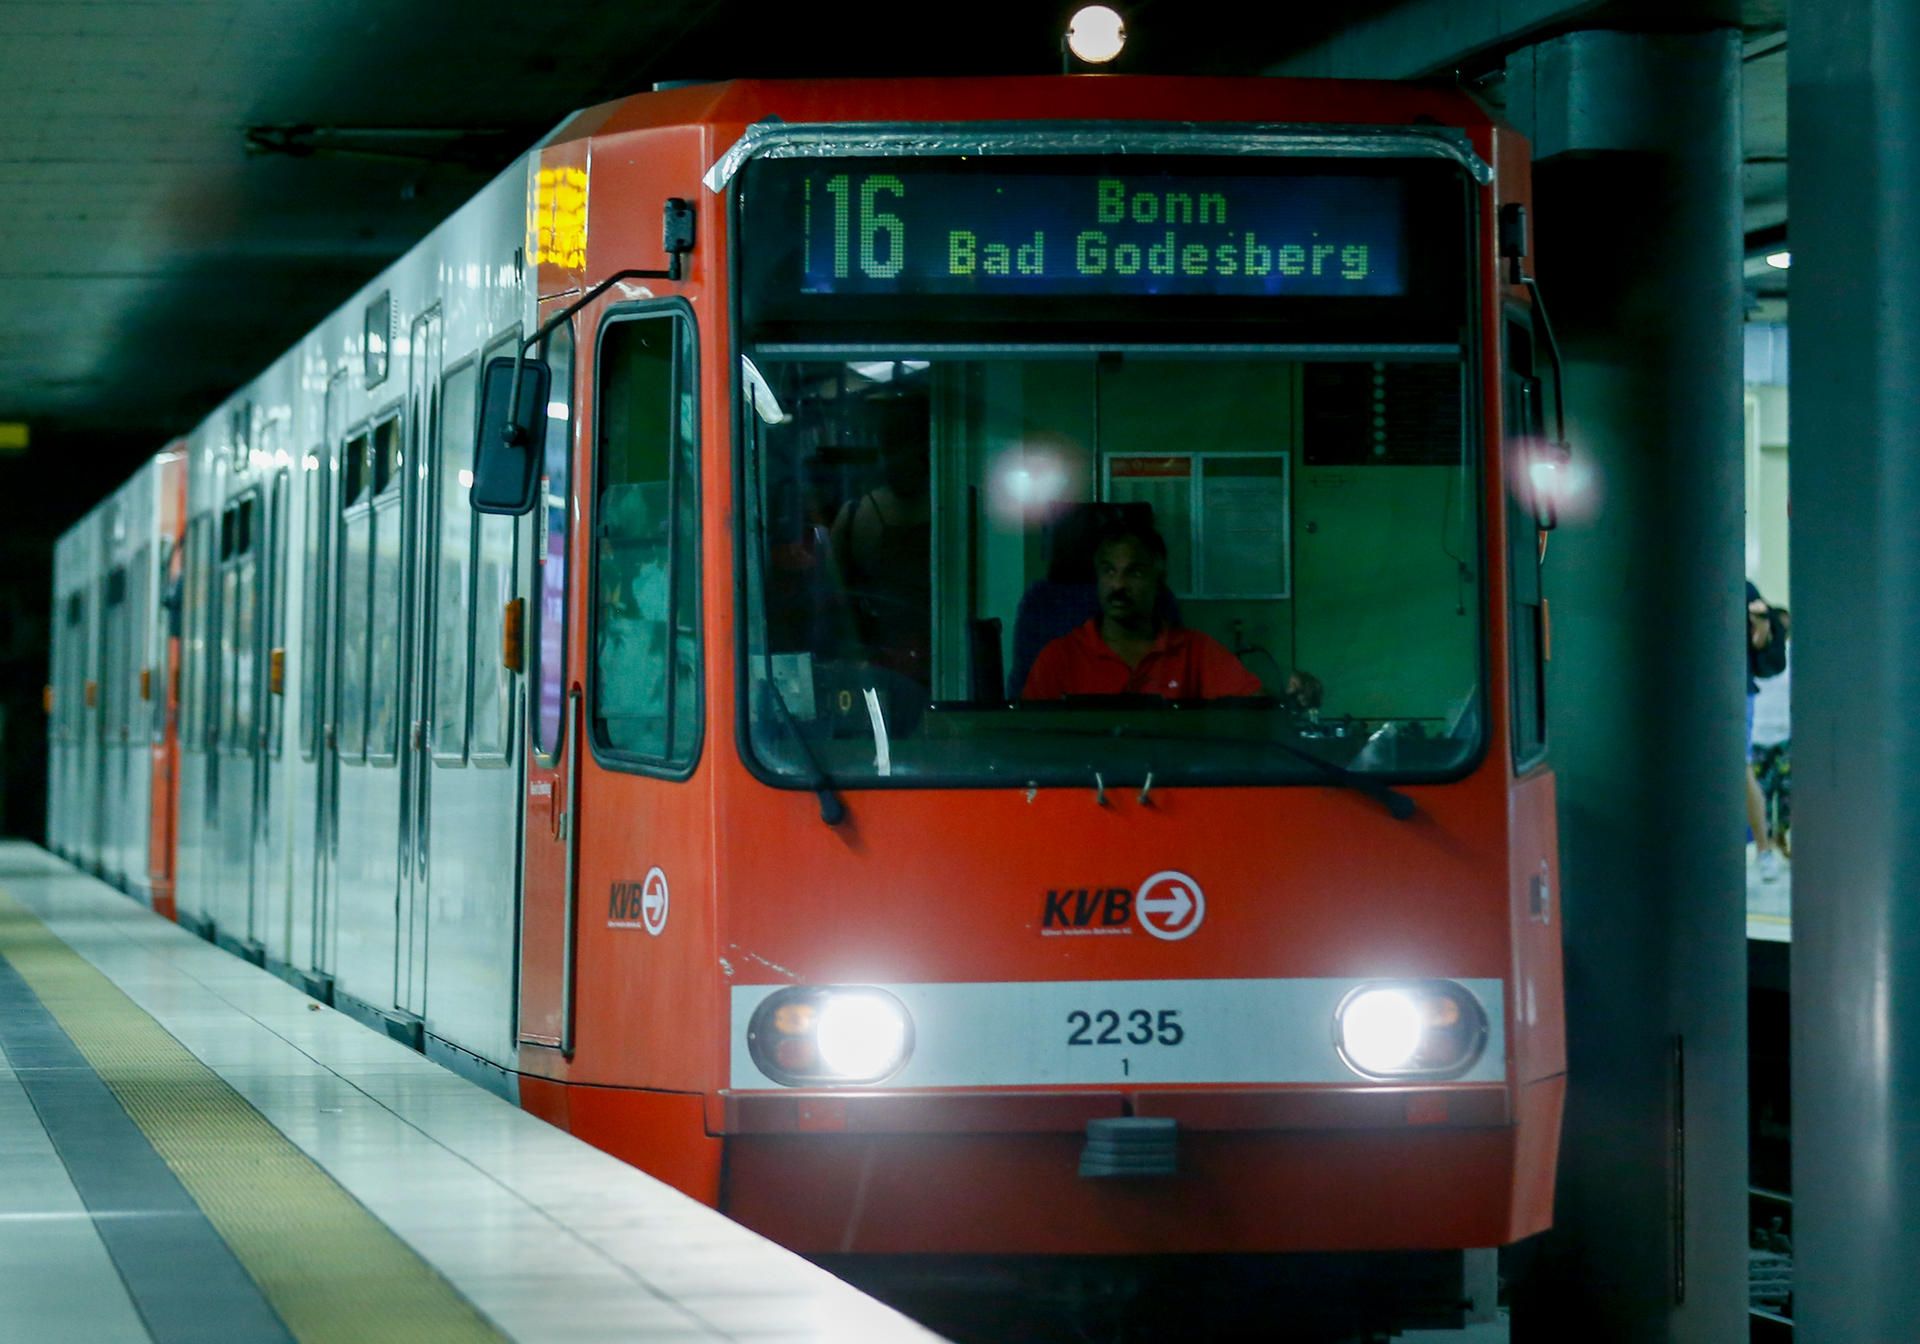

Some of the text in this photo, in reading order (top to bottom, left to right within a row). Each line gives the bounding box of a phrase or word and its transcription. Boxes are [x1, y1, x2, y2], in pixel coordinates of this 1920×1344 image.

[1098, 179, 1227, 223] Bonn
[827, 175, 904, 278] 16
[949, 231, 1368, 279] Bad Godesberg
[608, 882, 643, 919] KVB
[1042, 887, 1133, 928] KVB
[1066, 1009, 1185, 1046] 2235
[1121, 1058, 1130, 1076] 1
